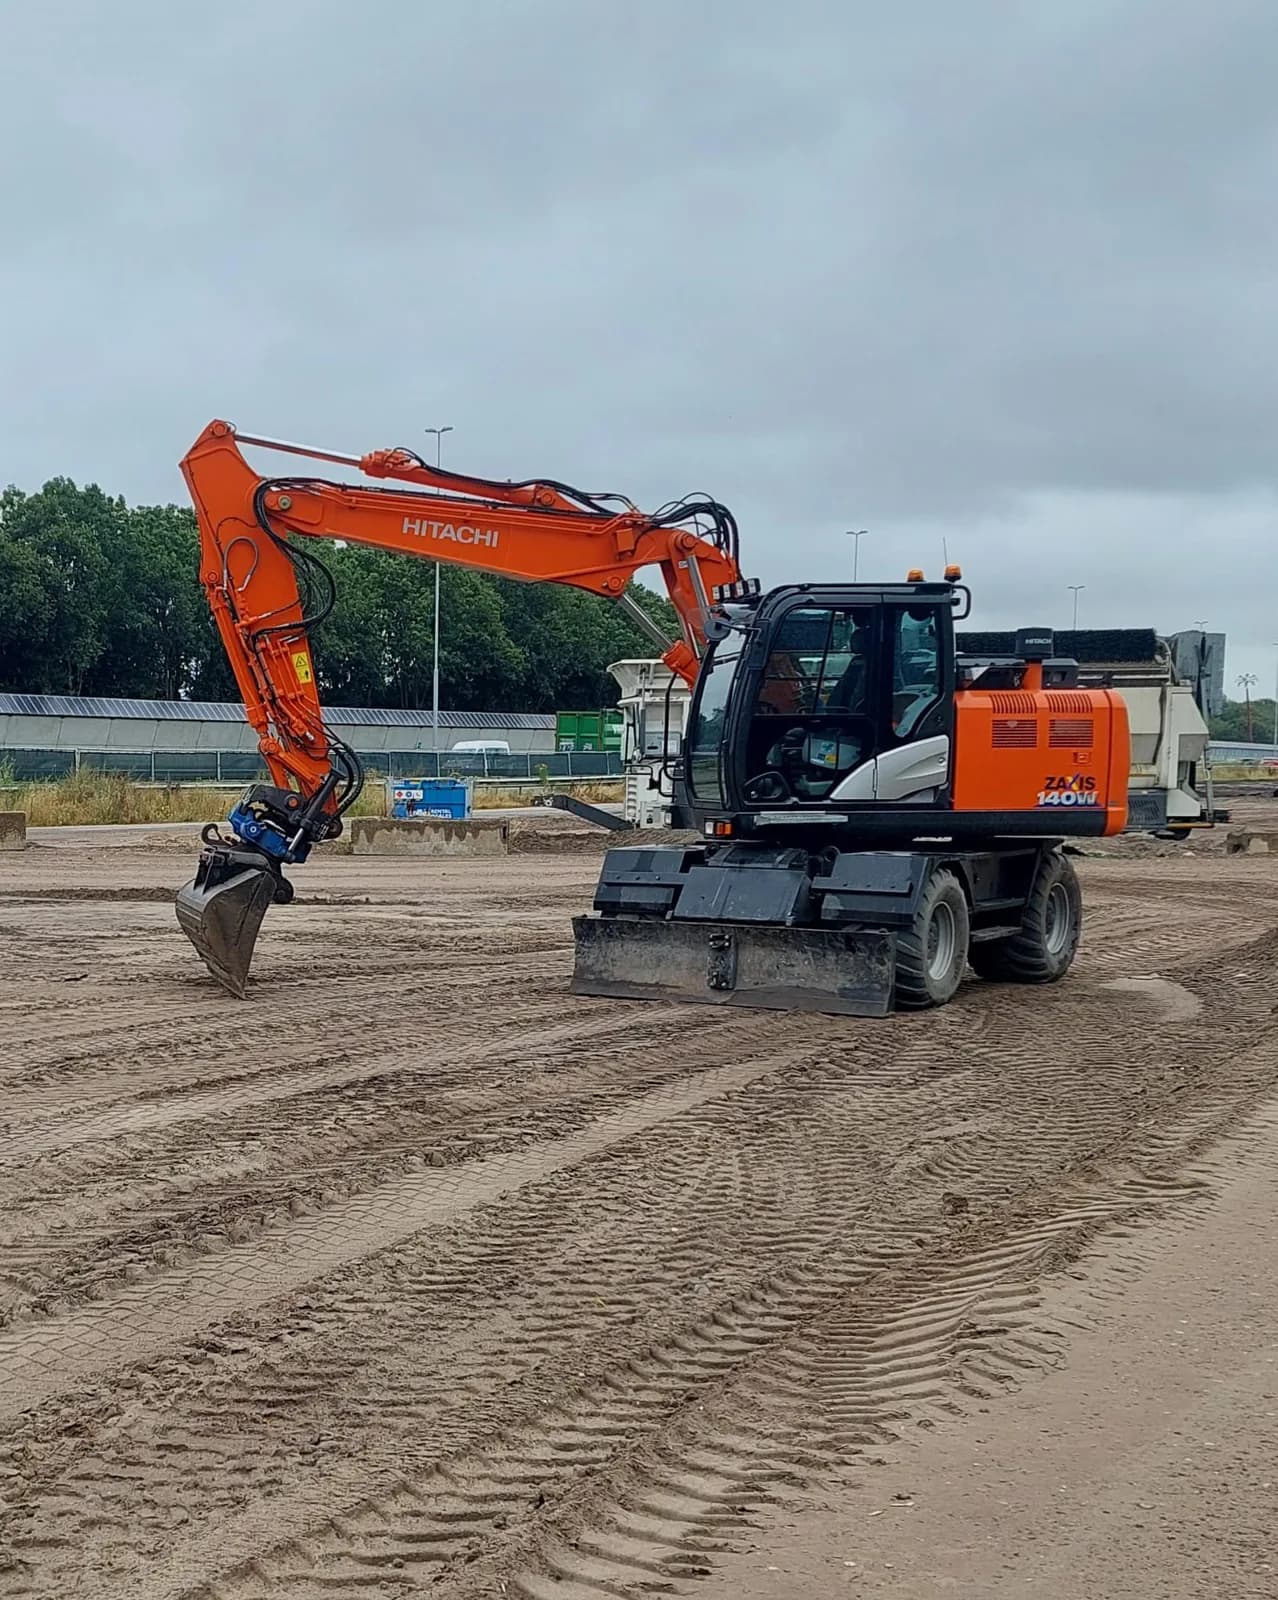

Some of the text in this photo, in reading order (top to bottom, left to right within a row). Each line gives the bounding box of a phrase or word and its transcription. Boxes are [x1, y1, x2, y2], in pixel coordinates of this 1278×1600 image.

[402, 517, 498, 547] HITACHI
[1045, 774, 1096, 790] ZAXIS
[1036, 791, 1099, 805] 140W
